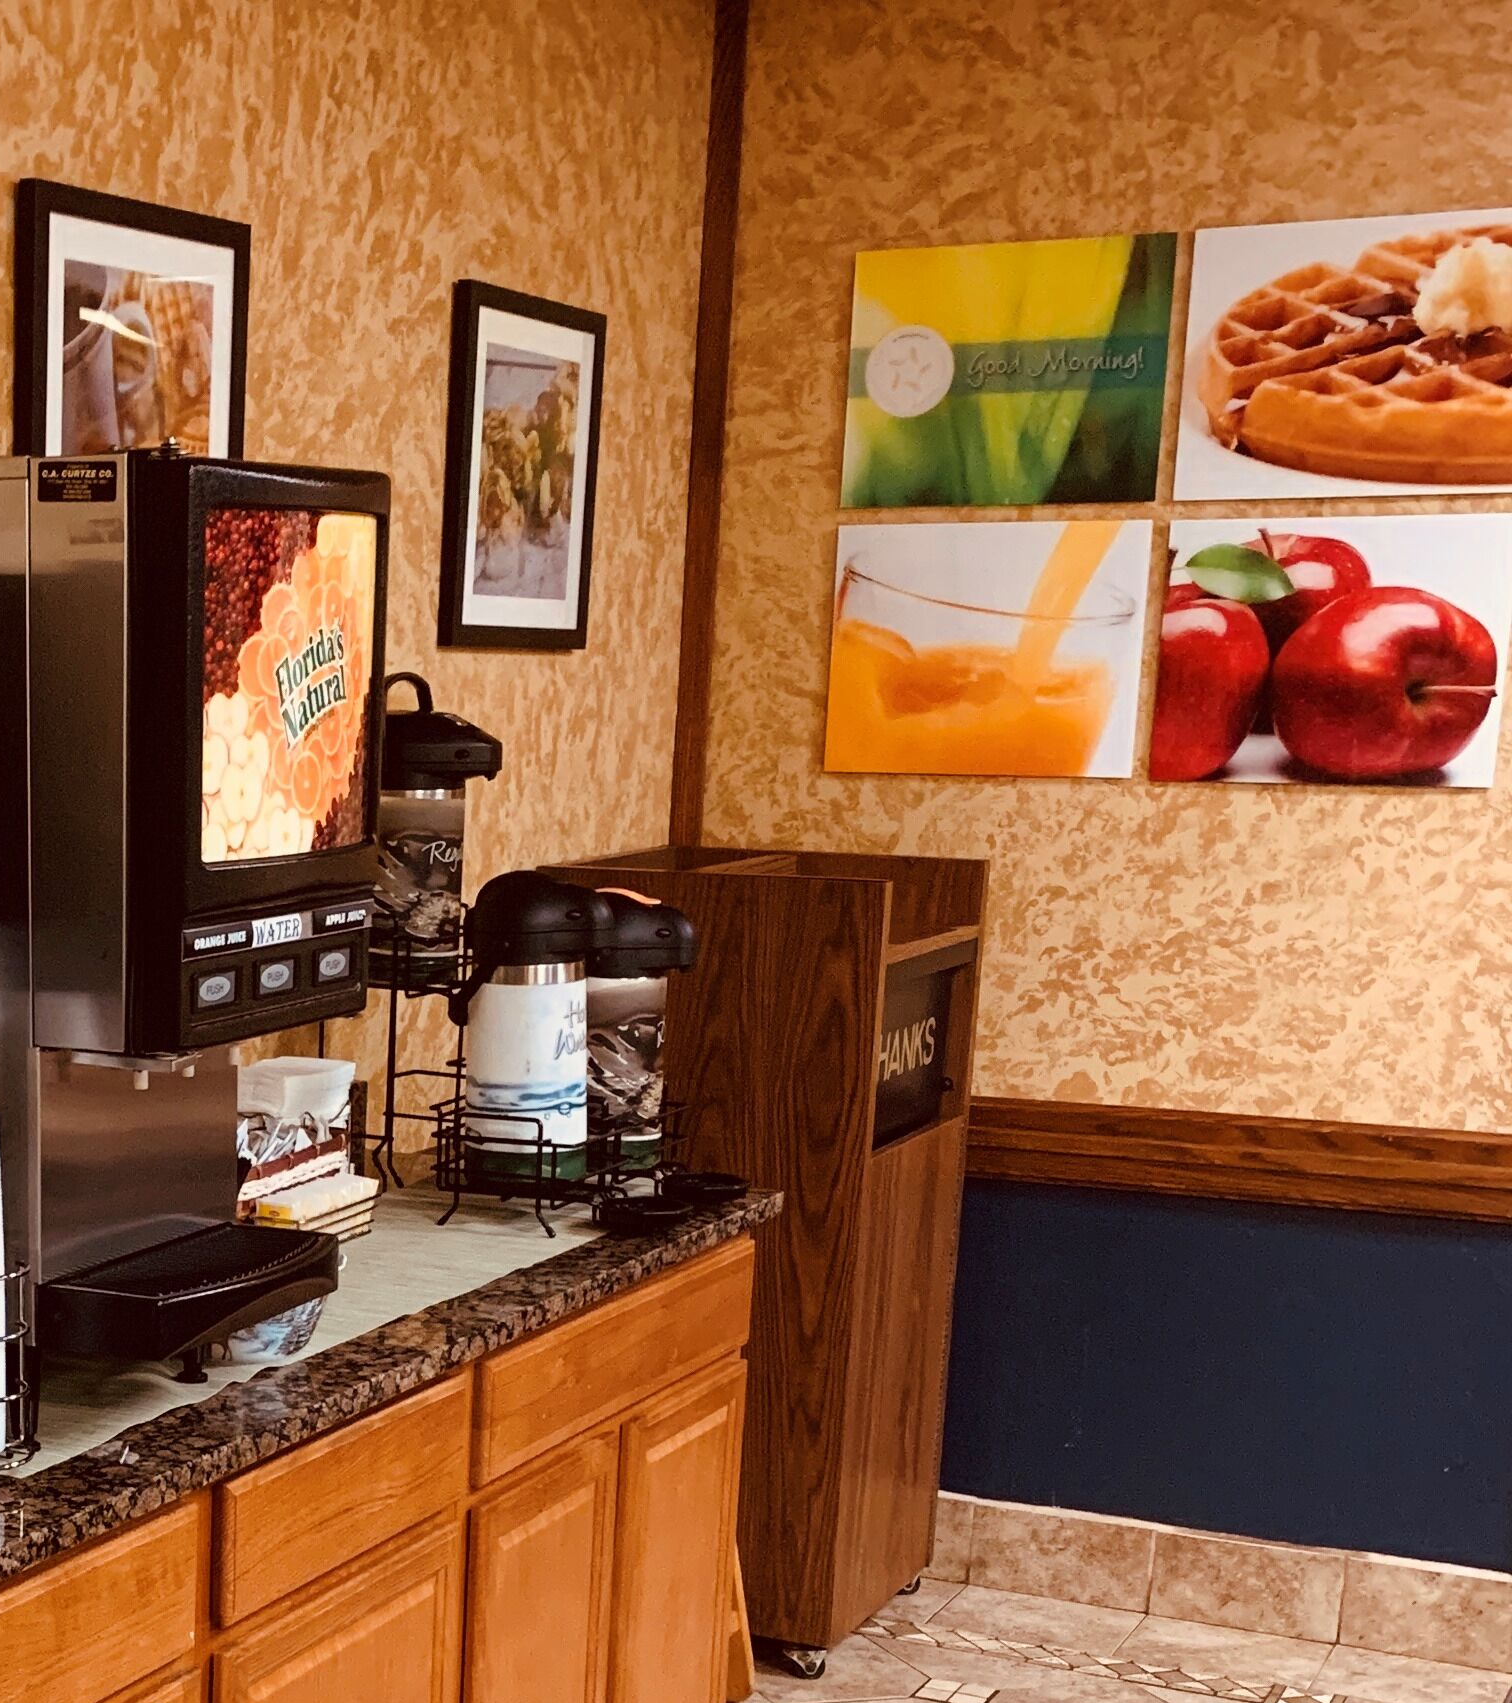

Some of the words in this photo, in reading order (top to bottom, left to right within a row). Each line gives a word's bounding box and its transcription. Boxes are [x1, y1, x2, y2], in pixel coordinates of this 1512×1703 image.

[967, 350, 1021, 388] Good
[1028, 346, 1145, 379] Morning!
[275, 625, 345, 707] Florida's
[281, 664, 347, 750] Natural
[254, 917, 300, 946] WATER
[325, 912, 346, 926] APPLE
[194, 933, 226, 950] ORANGE
[227, 930, 246, 944] JUICE
